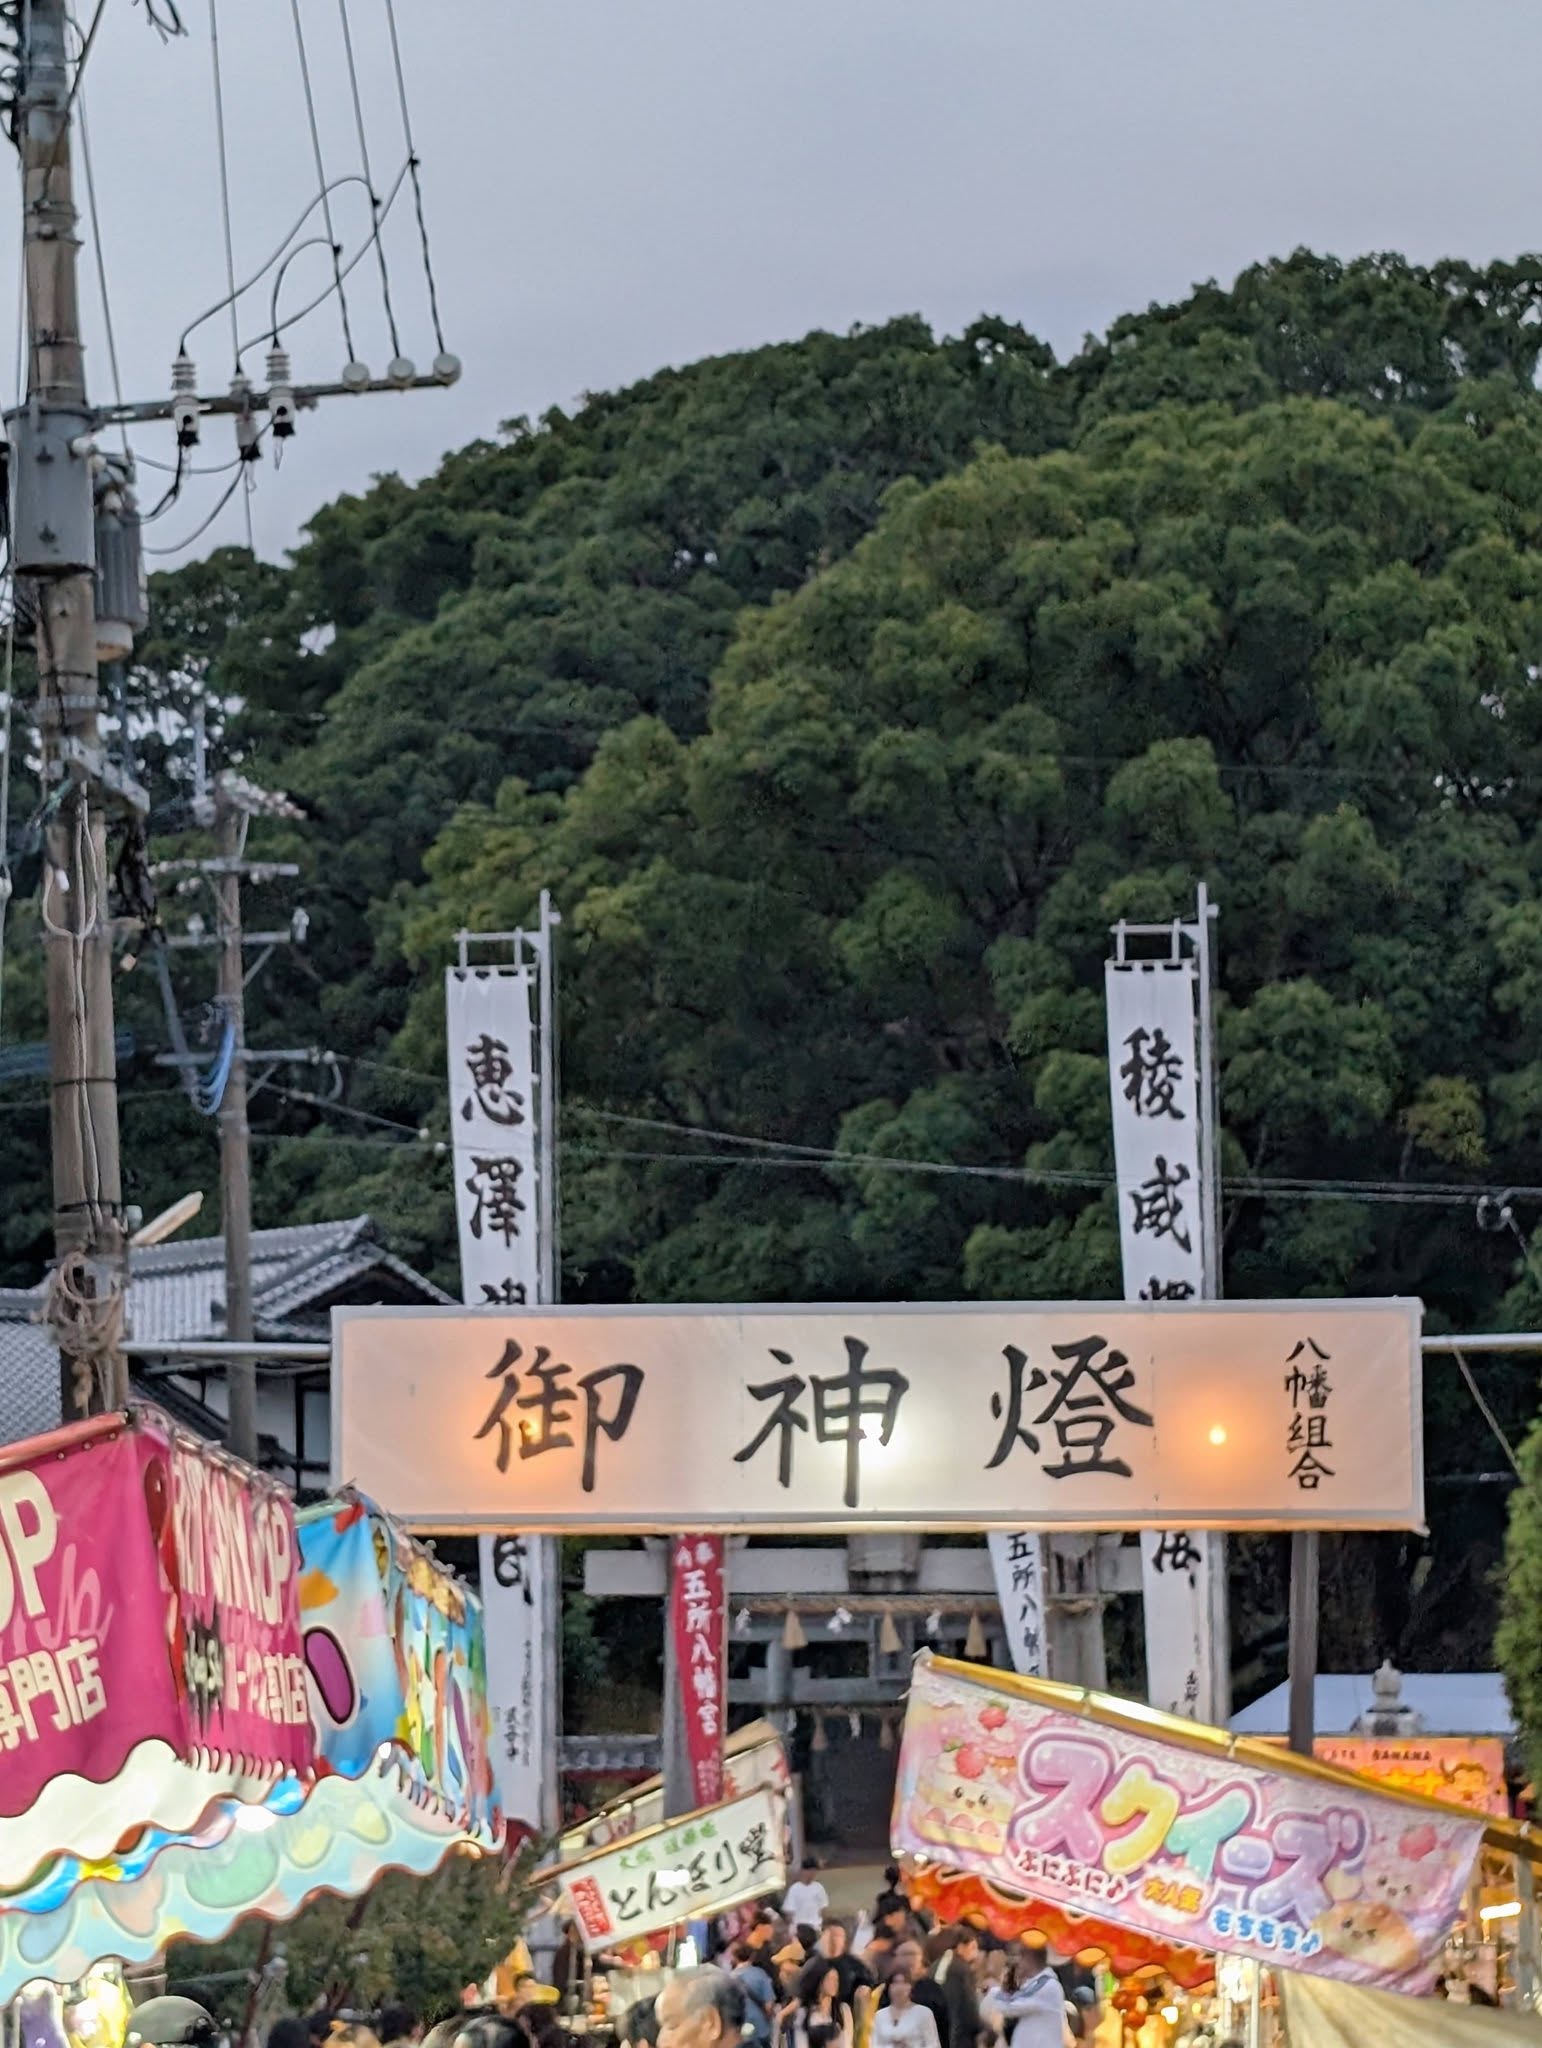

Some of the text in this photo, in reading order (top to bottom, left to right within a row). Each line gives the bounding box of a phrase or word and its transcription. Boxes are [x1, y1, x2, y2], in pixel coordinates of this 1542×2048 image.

[474, 1335, 1154, 1509] 御神燈
[1284, 1336, 1336, 1489] 八幡組合
[1012, 1736, 1364, 1930] スクイーズ
